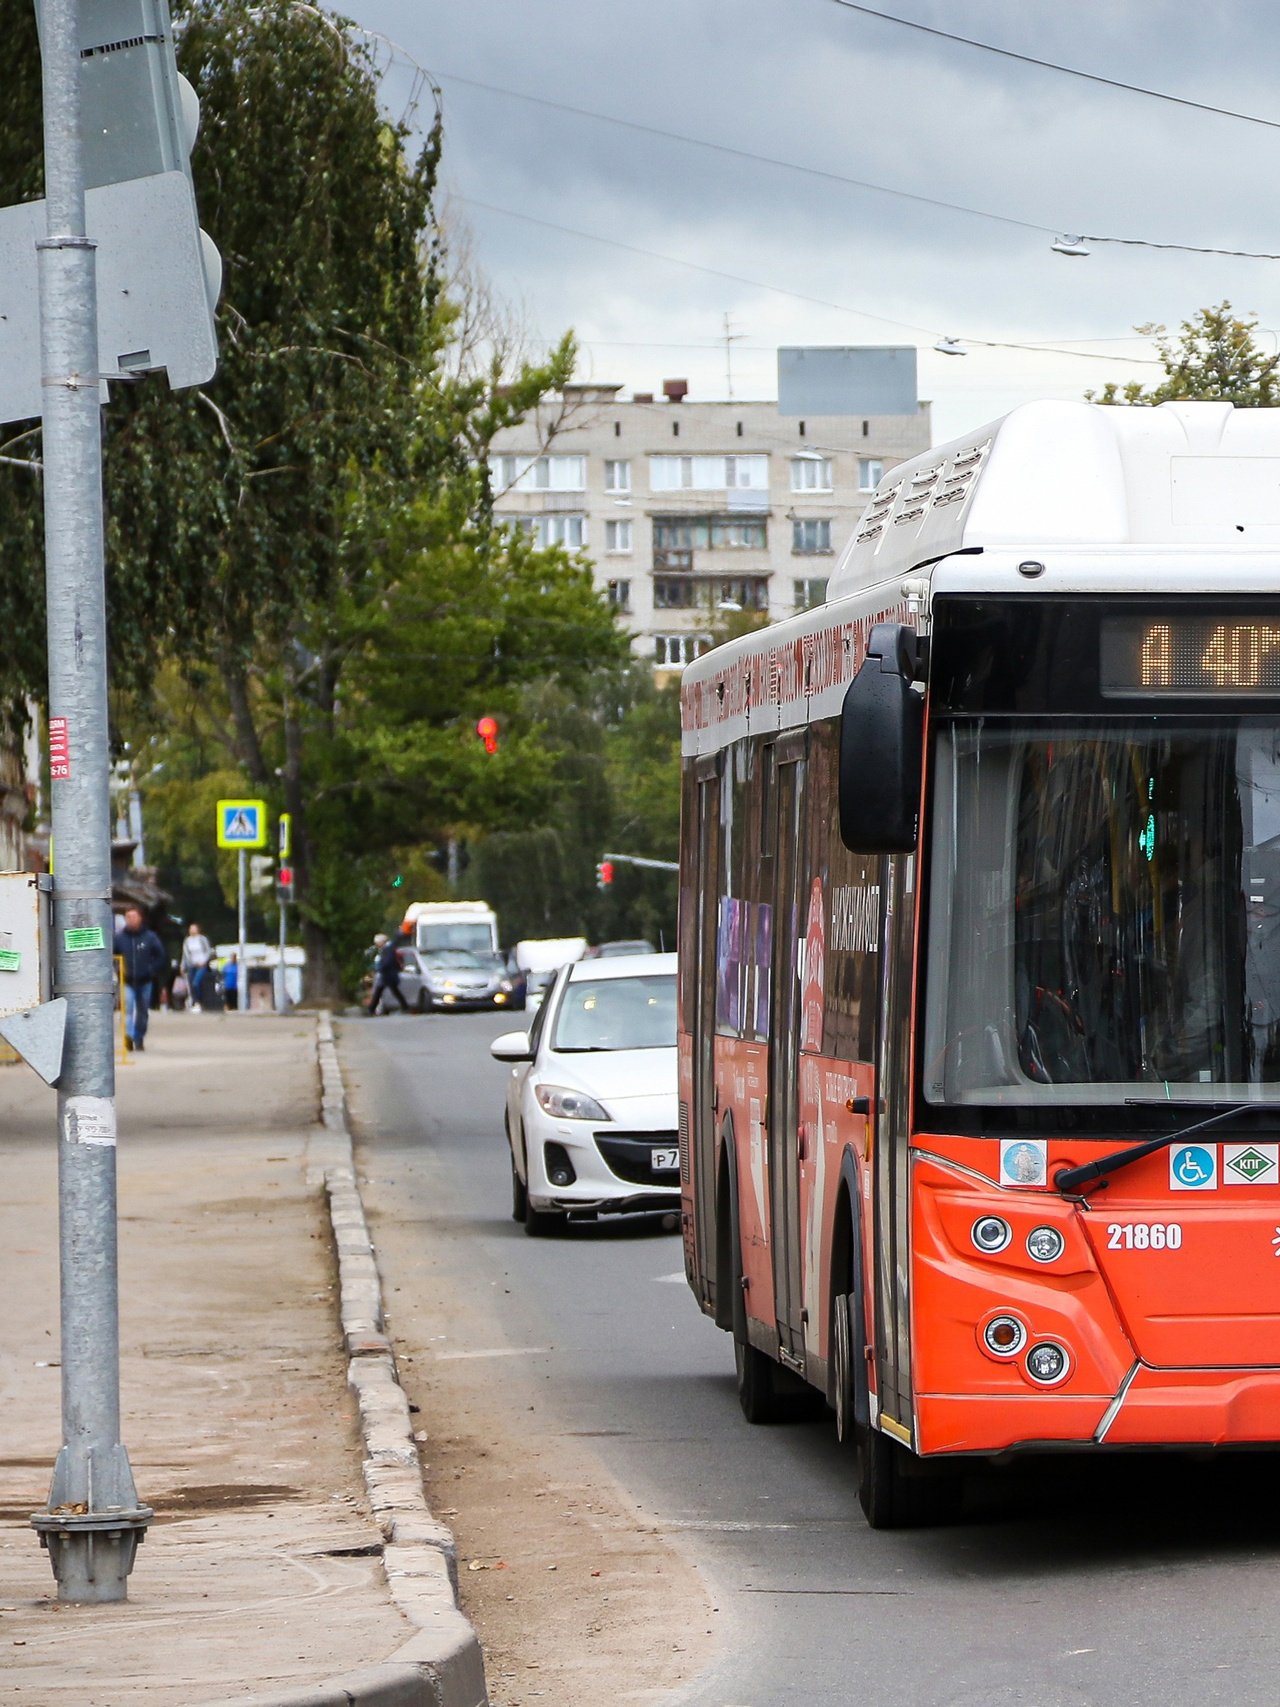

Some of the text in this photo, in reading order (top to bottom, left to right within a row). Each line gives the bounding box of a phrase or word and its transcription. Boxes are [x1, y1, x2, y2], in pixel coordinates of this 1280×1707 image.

[1201, 625, 1259, 686] 40
[1239, 1158, 1263, 1170] КПГ
[1107, 1223, 1182, 1250] 21860
